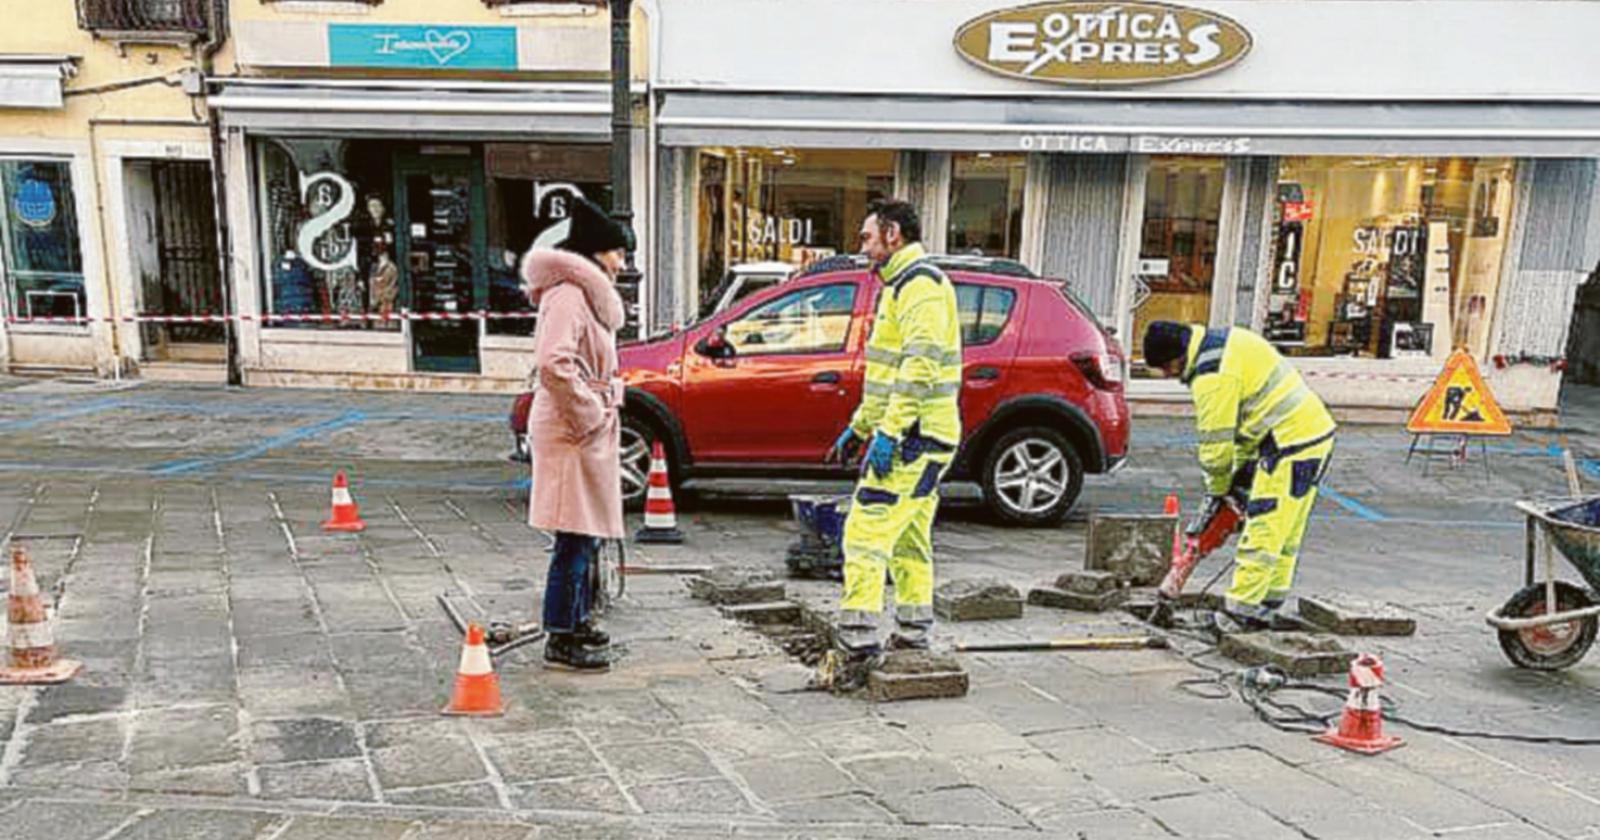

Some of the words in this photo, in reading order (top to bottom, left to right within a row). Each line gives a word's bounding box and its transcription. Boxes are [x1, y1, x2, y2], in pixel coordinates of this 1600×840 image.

[1042, 11, 1182, 39] OTTICA
[988, 20, 1221, 75] EXPRESS
[1019, 135, 1108, 152] OTTICA
[750, 215, 813, 244] SALDI
[1352, 228, 1419, 255] SALDI
